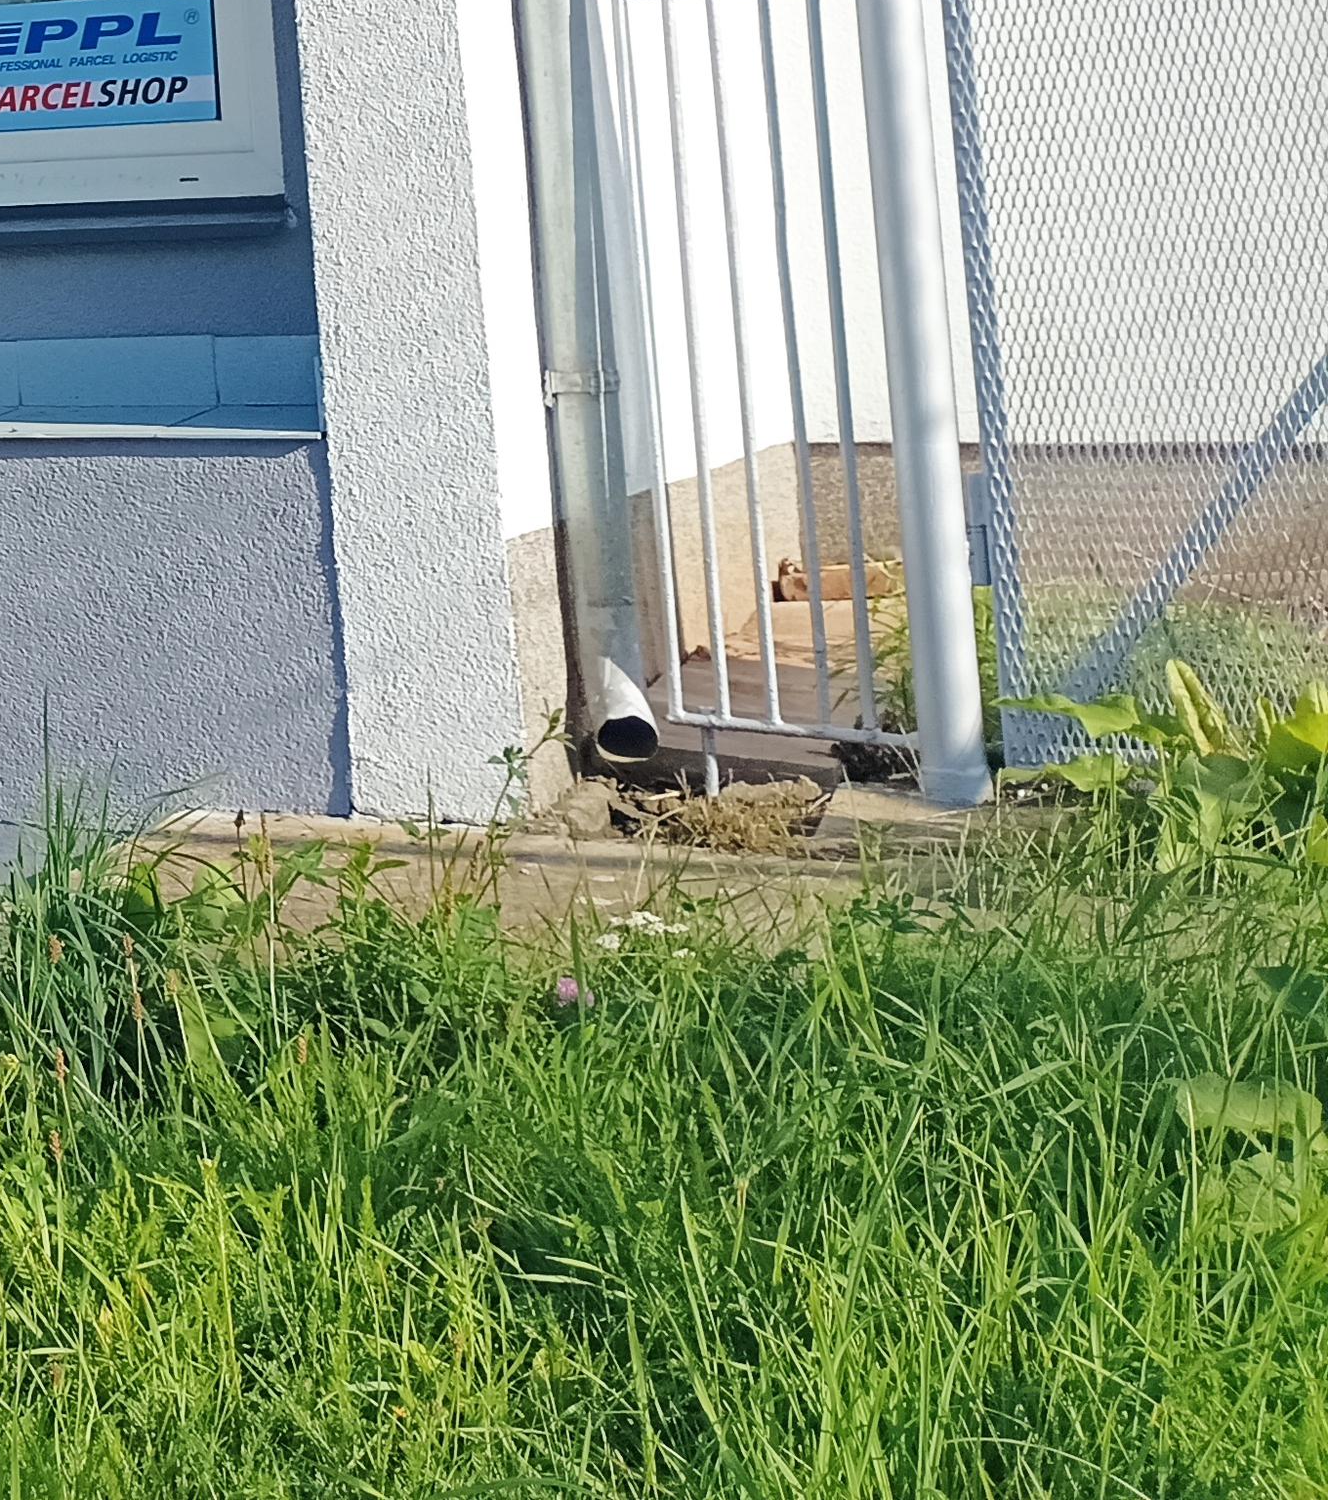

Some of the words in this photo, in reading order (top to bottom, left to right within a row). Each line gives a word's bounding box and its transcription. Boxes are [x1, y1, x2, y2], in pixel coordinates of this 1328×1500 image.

[24, 12, 182, 54] PPL
[69, 55, 117, 67] PARCEL
[122, 51, 178, 64] LOGISTIC
